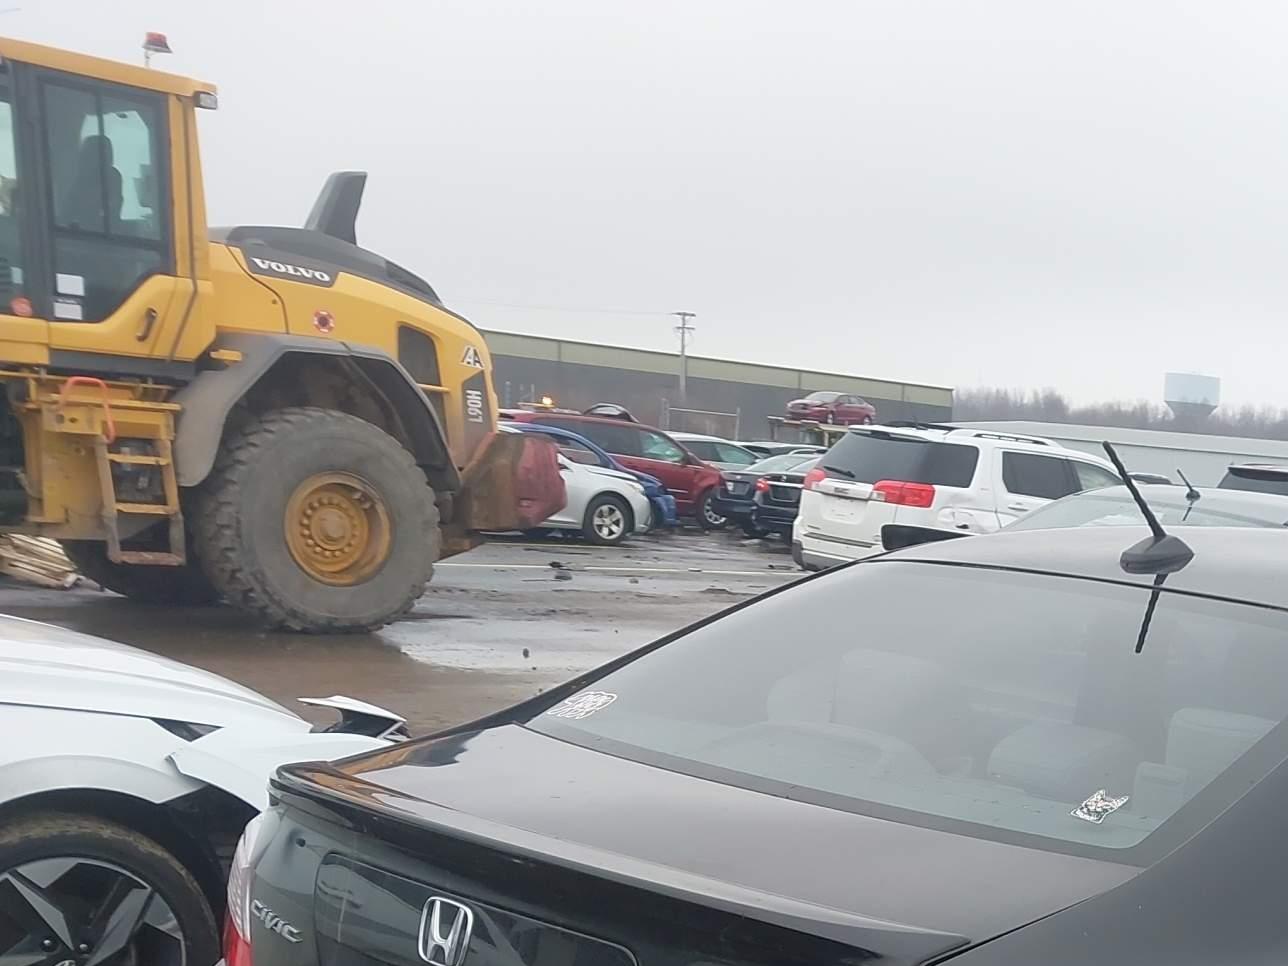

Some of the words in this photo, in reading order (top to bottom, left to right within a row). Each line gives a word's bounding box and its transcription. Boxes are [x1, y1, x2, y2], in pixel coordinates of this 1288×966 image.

[250, 256, 331, 282] VOLVO
[466, 389, 484, 424] L90H
[250, 899, 304, 943] CIVIC
